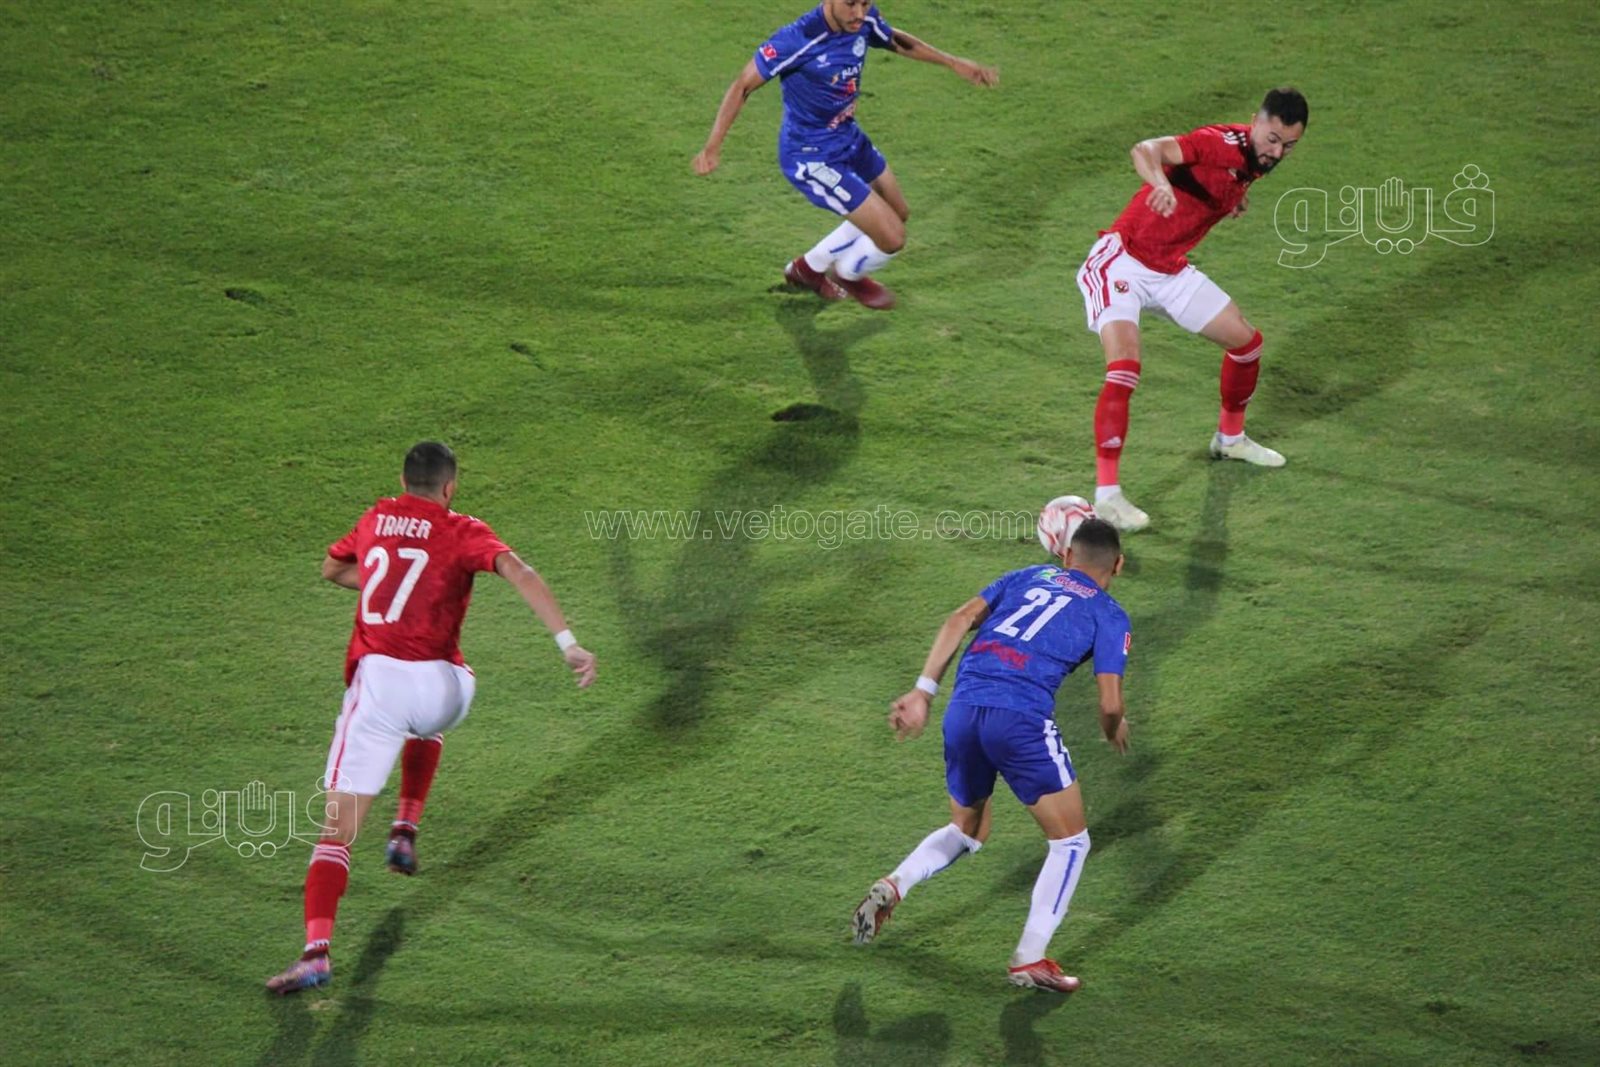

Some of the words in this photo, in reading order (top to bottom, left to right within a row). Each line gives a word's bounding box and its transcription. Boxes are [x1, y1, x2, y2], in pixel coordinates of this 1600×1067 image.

[374, 513, 433, 540] TAHER
[361, 545, 430, 625] 27
[992, 586, 1073, 642] 21
